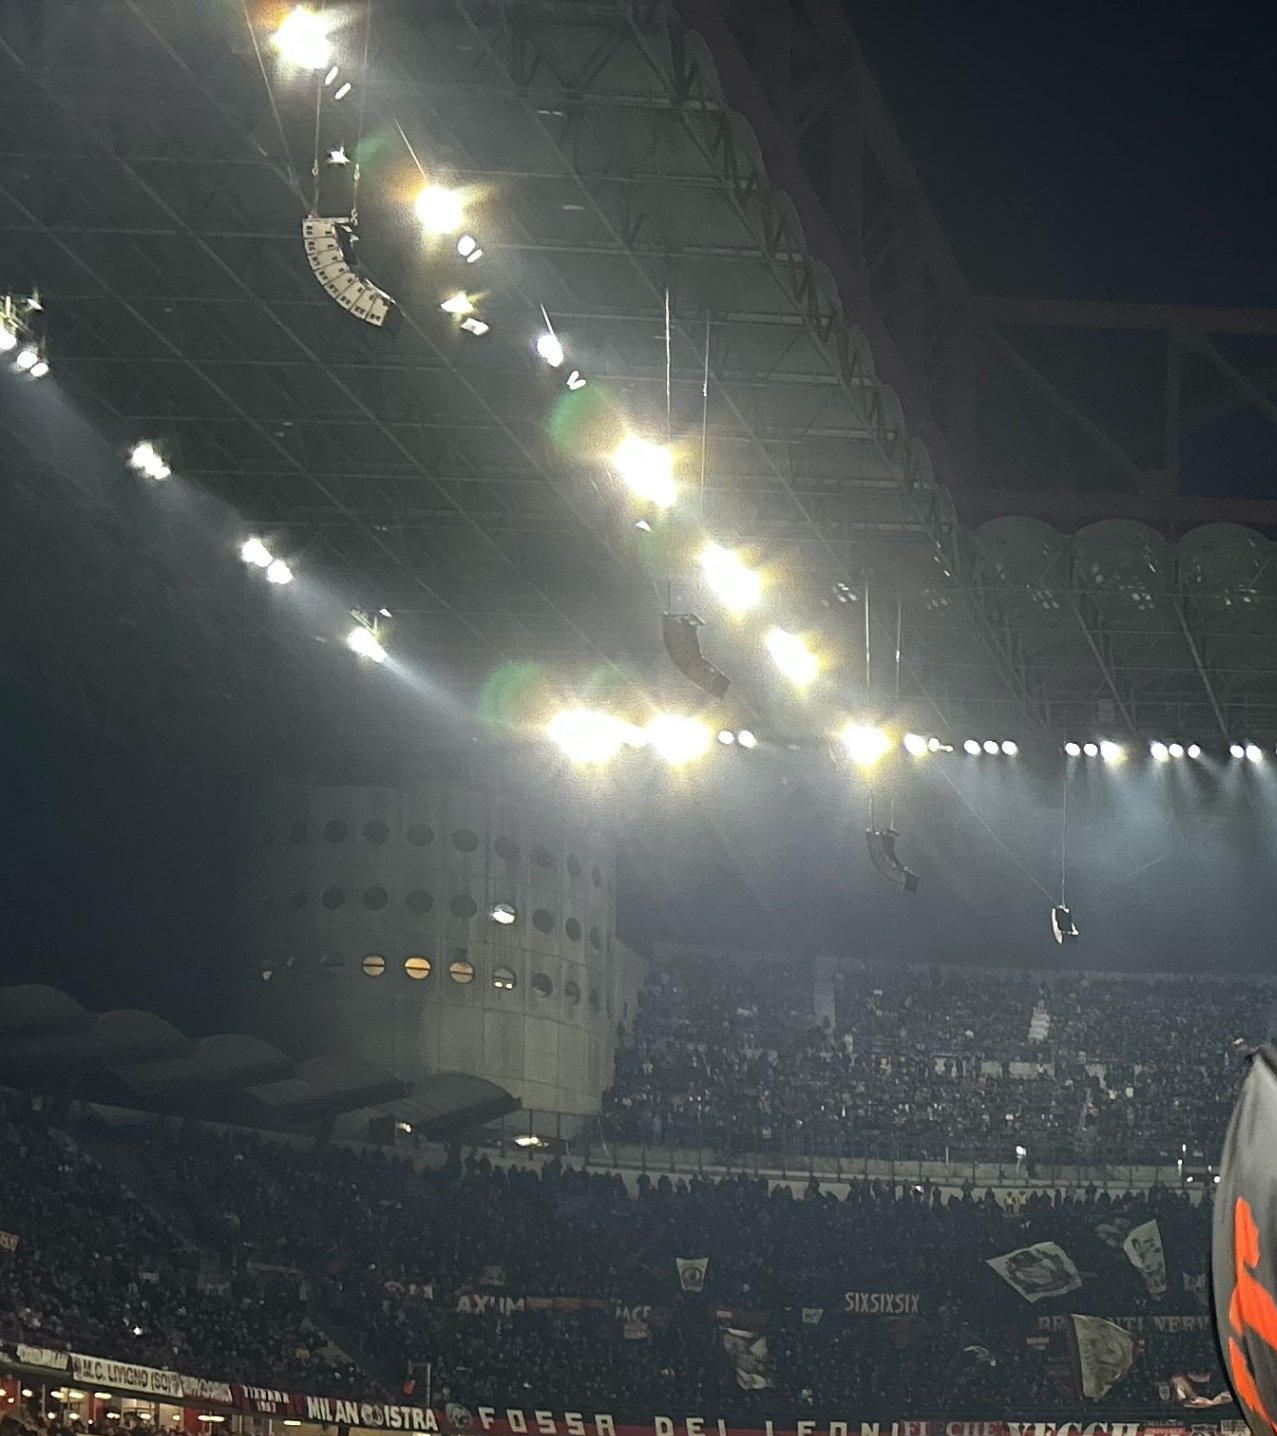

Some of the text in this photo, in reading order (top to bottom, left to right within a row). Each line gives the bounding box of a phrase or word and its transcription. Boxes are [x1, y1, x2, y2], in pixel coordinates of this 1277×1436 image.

[845, 1291, 920, 1313] SIXSIXSIX
[306, 1395, 439, 1432] MILAN ISTRA
